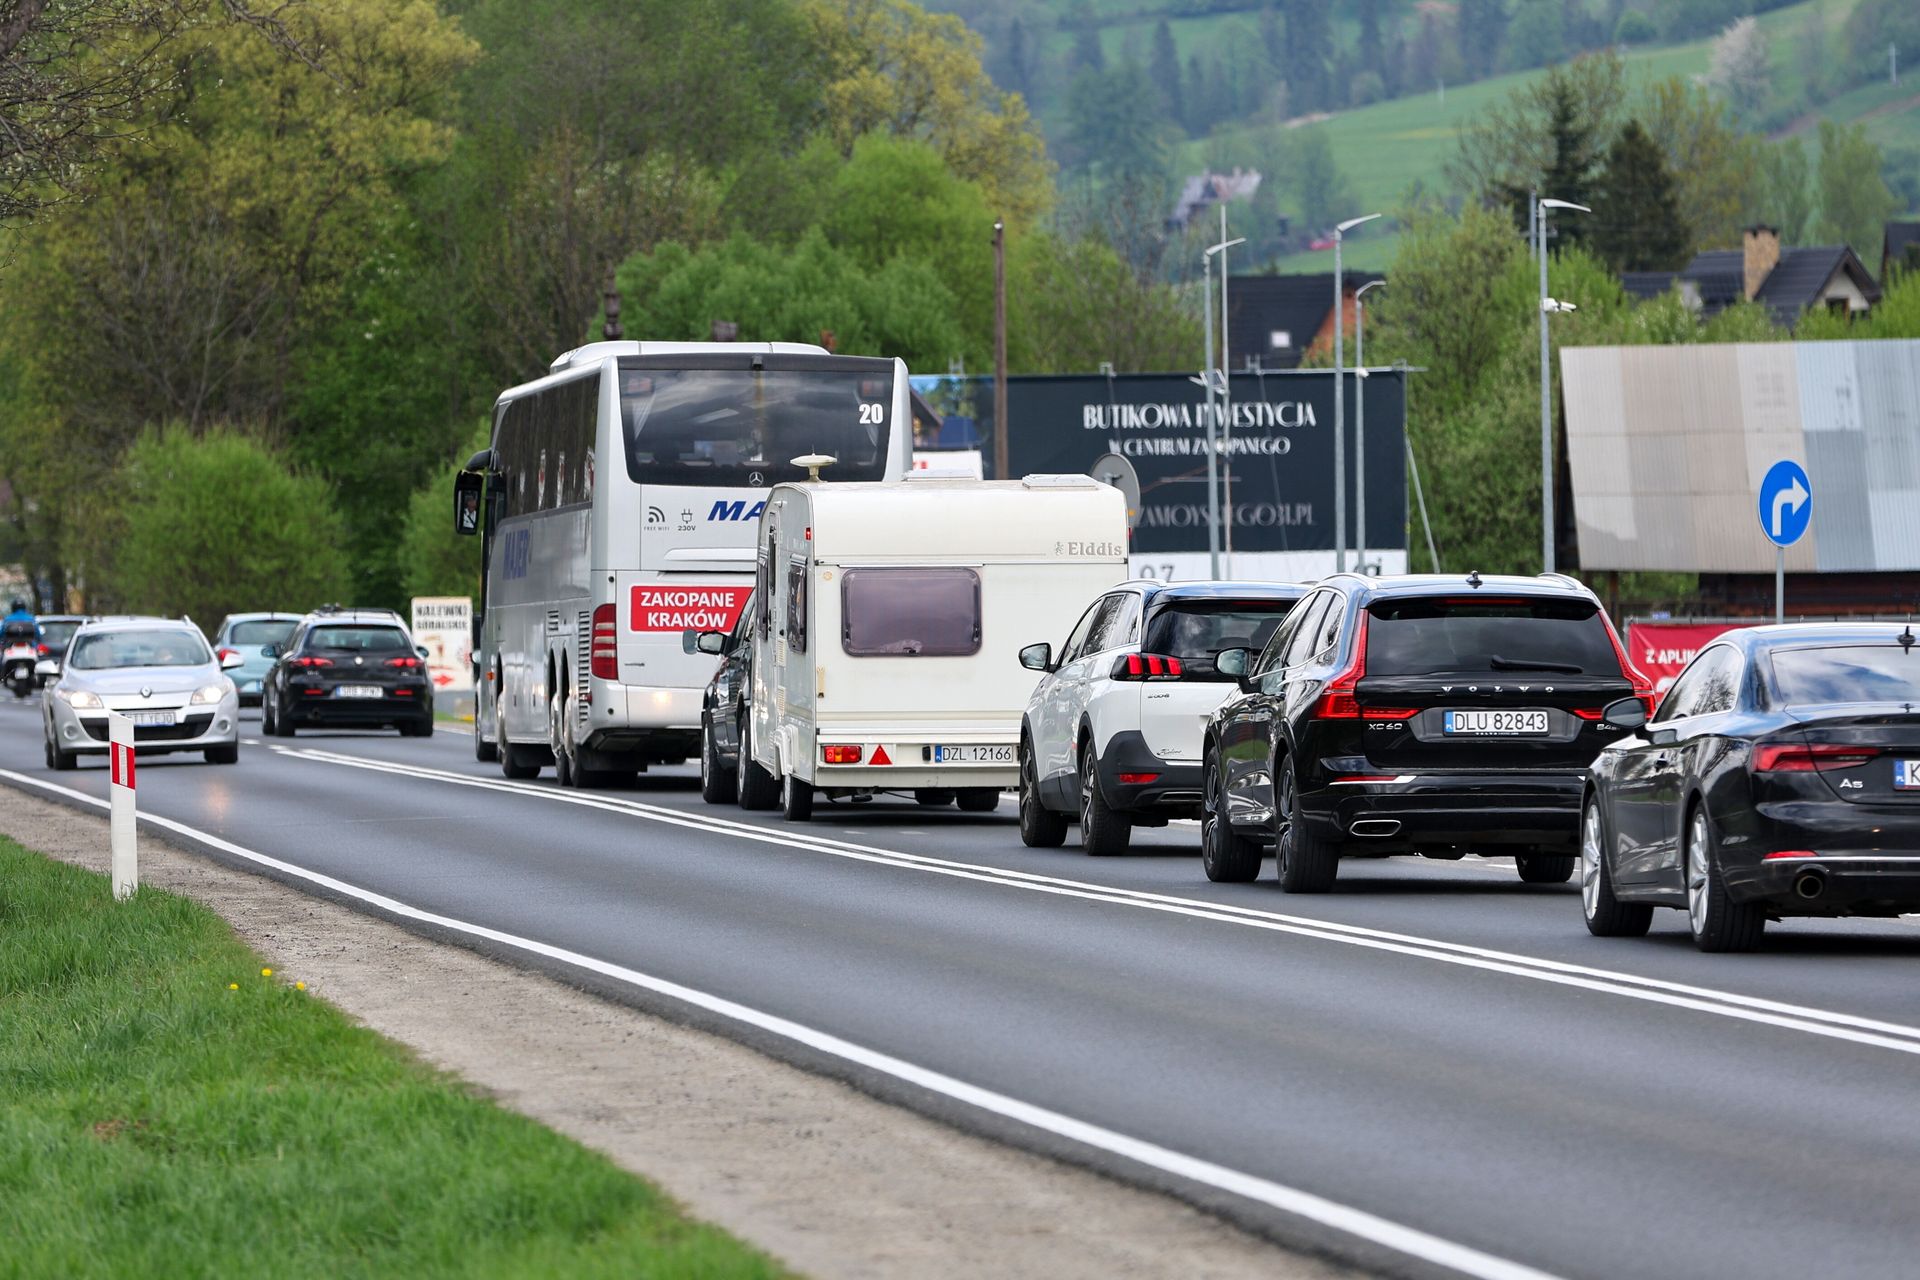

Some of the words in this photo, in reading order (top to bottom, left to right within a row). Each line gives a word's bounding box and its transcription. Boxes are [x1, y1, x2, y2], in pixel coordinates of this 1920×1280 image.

[859, 403, 884, 424] 20
[1083, 403, 1192, 429] BUTIKOWA
[1123, 437, 1191, 456] CENTRUM
[1068, 542, 1122, 556] Elddis
[641, 592, 735, 607] ZAKOPANE
[648, 609, 727, 628] KRAKÓW
[1646, 649, 1656, 664] Z
[1454, 713, 1488, 730] DLU
[1493, 713, 1546, 730] 82843
[943, 747, 967, 761] DZL
[973, 747, 1011, 761] 12166
[1910, 762, 1920, 784] K
[1840, 778, 1864, 789] A5
